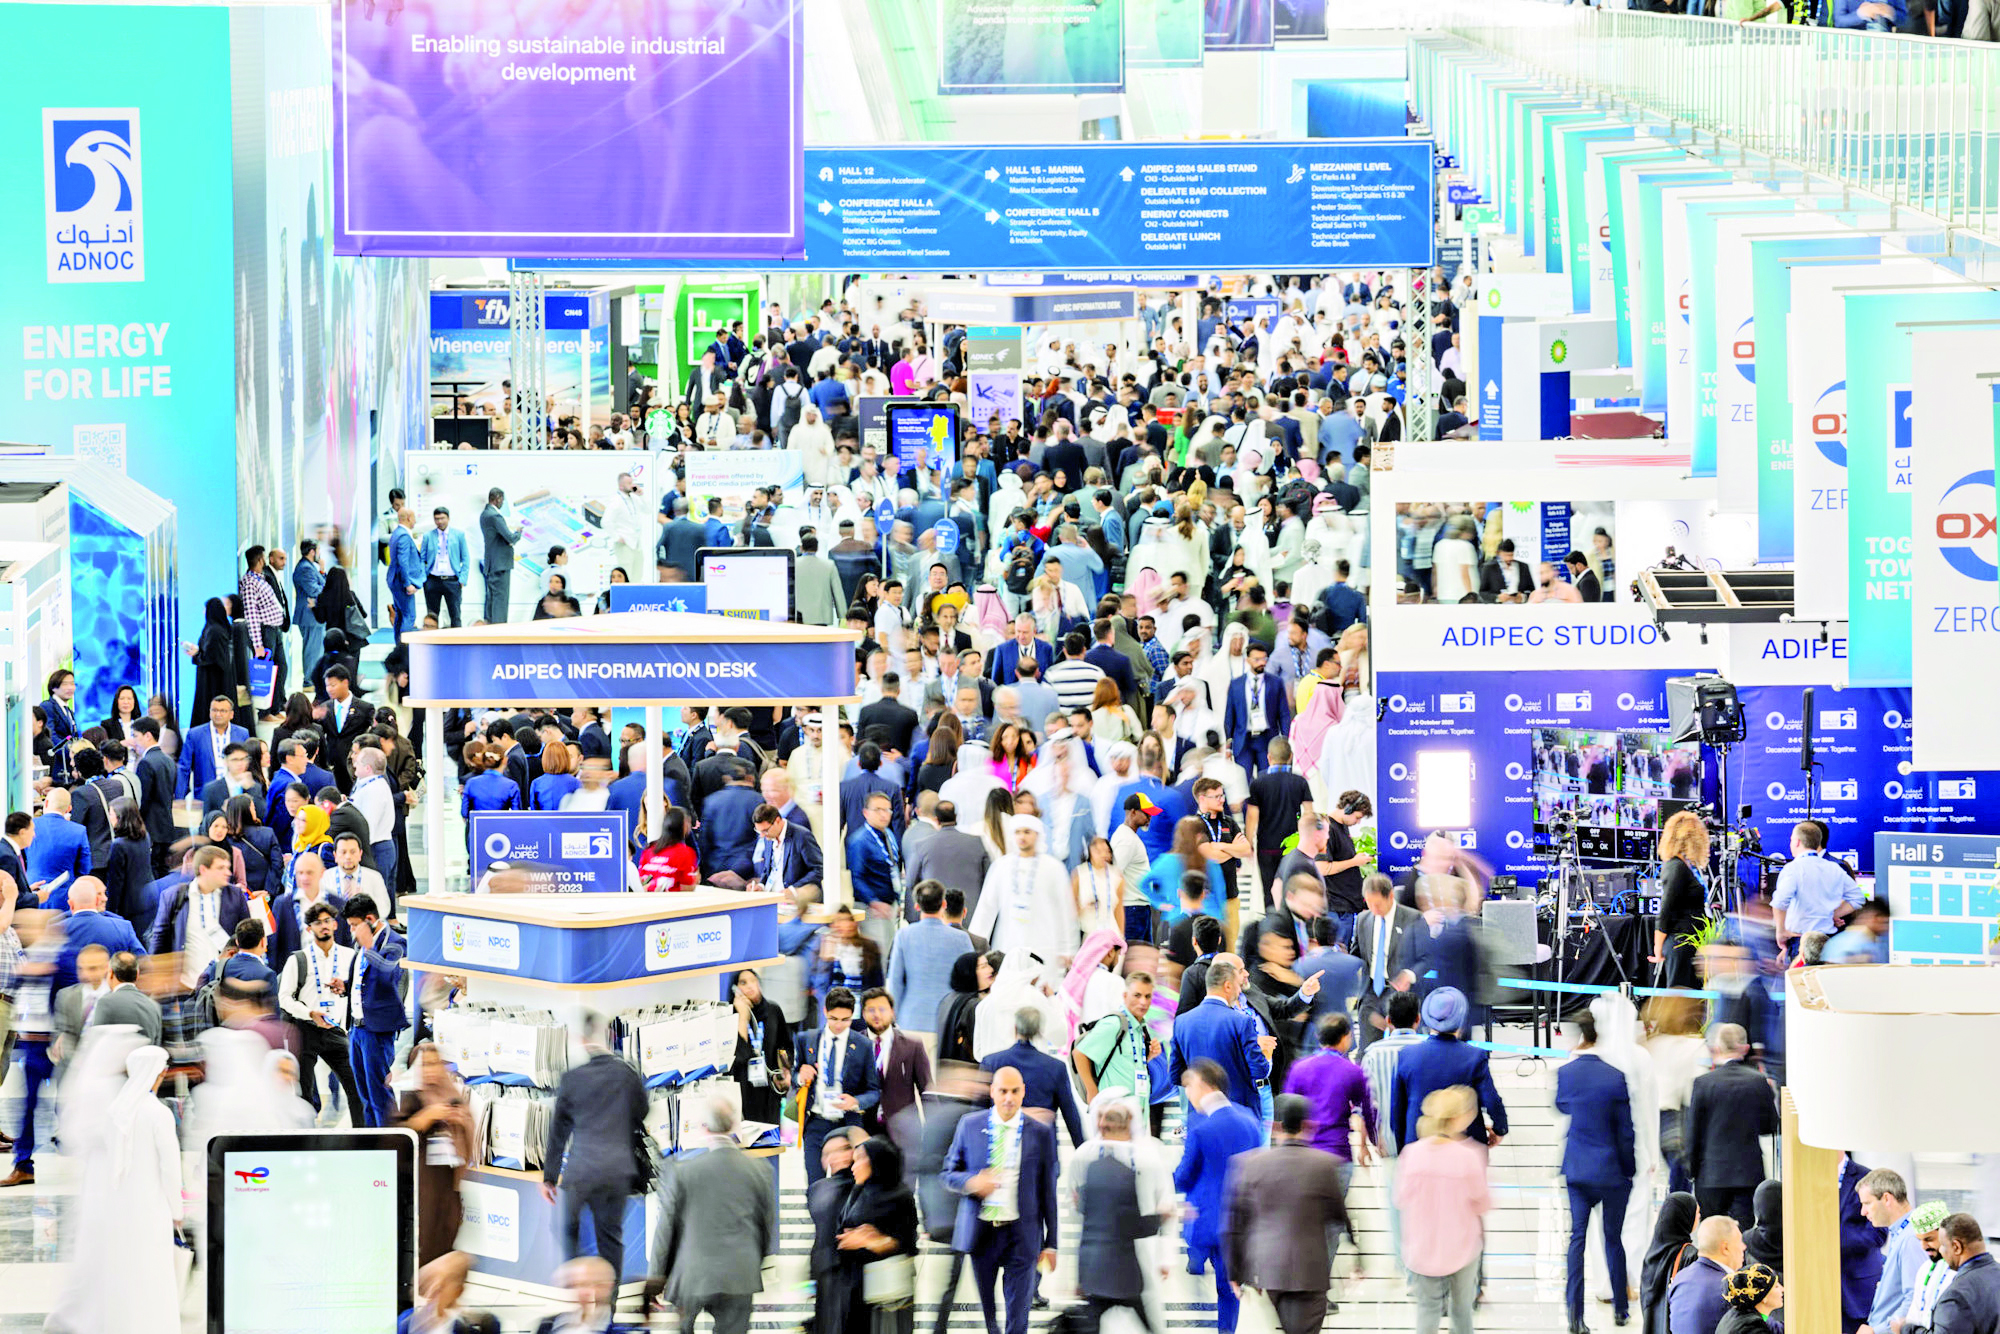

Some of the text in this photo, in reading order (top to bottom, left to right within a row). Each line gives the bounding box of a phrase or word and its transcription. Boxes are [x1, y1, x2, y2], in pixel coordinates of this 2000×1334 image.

[967, 5, 1010, 14] Advancing
[1028, 4, 1096, 12] decarbonisation
[972, 17, 1004, 25] agenda
[1028, 16, 1051, 25] goals
[411, 34, 725, 57] Enabling sustainable industrial
[502, 63, 636, 84] development
[839, 167, 874, 175] HALL 12
[1006, 166, 1029, 174] HALL
[1031, 166, 1041, 174] 15
[1048, 166, 1084, 174] MARINA
[1140, 164, 1257, 173] ADIPEC 2024 SALES STAND
[1310, 163, 1392, 171] MEZZANINE LEVEL
[1140, 187, 1267, 196] DELEGATE BAG COLLECTION
[839, 199, 934, 207] CONFERENCE HALL A
[1005, 208, 1100, 216] CONFERENCE HALL B
[1140, 210, 1229, 218] ENERGY CONNECTS
[1009, 219, 1036, 227] Strategic
[56, 219, 133, 248] أدنوك
[1068, 229, 1088, 237] Equity
[1140, 233, 1221, 241] DELEGATE LUNCH
[58, 251, 134, 270] ADNOC
[1064, 274, 1109, 282] Delegate
[1111, 274, 1132, 282] Bag
[1053, 301, 1121, 312] ADIPEC INFORMATION DESK
[485, 300, 515, 325] fly
[23, 322, 170, 360] ENERGY
[24, 365, 172, 400] FOR LIFE
[1865, 581, 1912, 600] NET
[628, 604, 665, 612] ADNEC
[727, 610, 757, 620] SHOW
[1442, 625, 1657, 646] ADIPEC STUDIO
[492, 662, 757, 680] ADIPEC INFORMATION DESK
[509, 851, 539, 859] ADIPEC
[1891, 843, 1927, 861] Hall
[1932, 845, 1944, 862] 5
[530, 872, 595, 881] WAY TO THE
[523, 884, 583, 892] DIPEC 2023
[697, 931, 721, 943] NPCC
[488, 936, 510, 948] NPCC
[488, 1213, 510, 1227] NPCC
